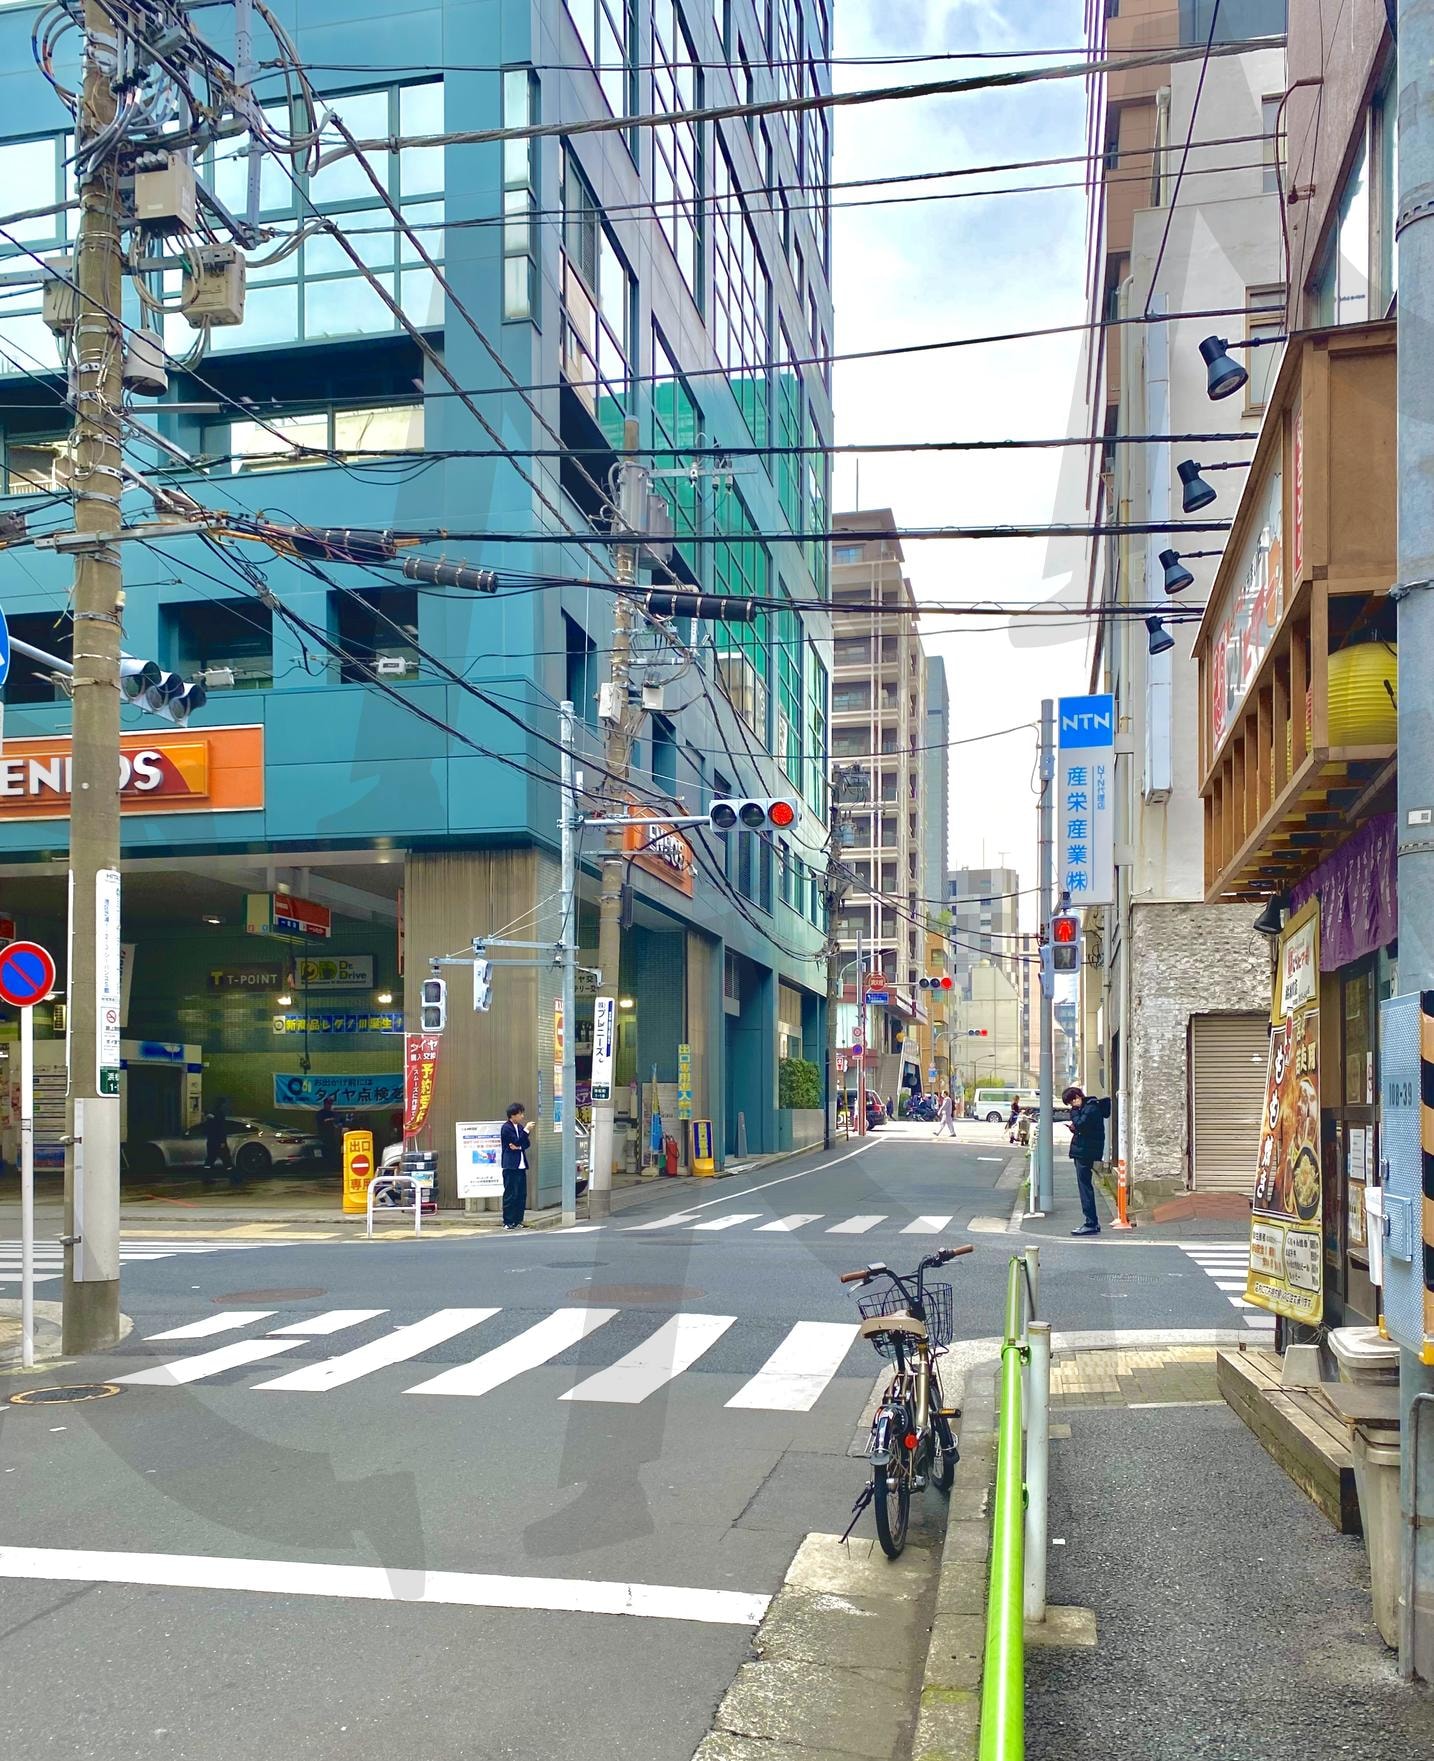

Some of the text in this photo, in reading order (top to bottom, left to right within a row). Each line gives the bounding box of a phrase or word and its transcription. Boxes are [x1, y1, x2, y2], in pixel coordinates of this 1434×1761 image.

[1062, 712, 1110, 732] NTN
[0, 750, 163, 796] ENS
[227, 973, 278, 985] T-POINT
[339, 970, 367, 980] Drive
[410, 1039, 438, 1053] タイヤ
[1388, 1081, 1413, 1107] 108-39
[350, 1140, 370, 1153] 出口
